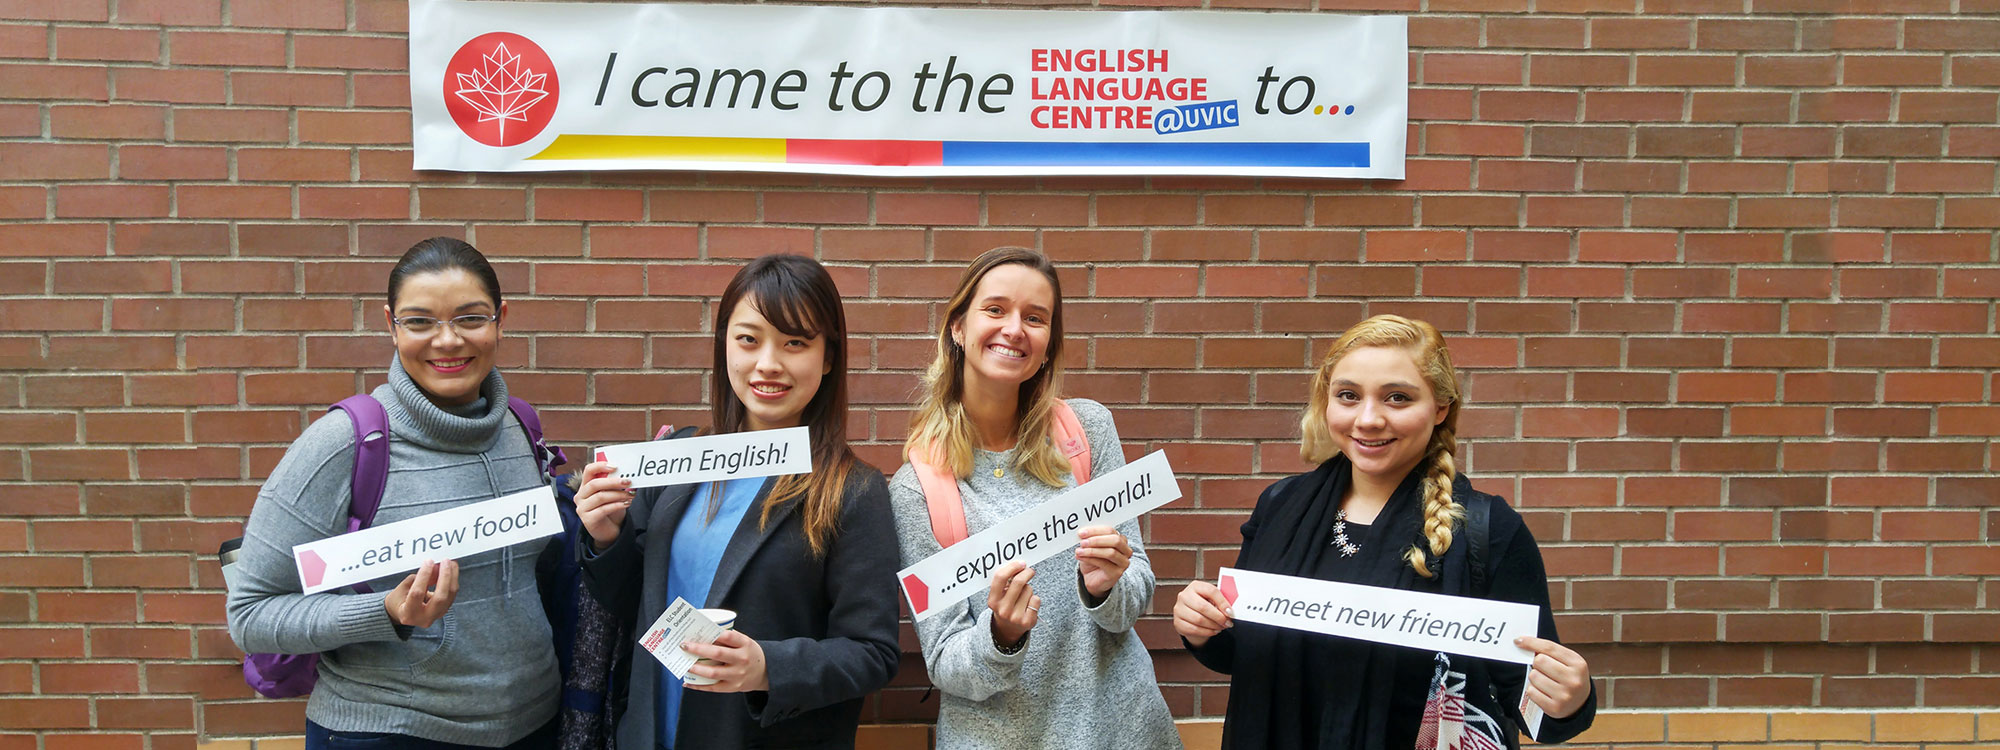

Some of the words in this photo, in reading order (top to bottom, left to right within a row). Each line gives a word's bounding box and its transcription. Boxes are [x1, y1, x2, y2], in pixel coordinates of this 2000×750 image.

[594, 52, 618, 106] I
[631, 66, 808, 111] came
[828, 61, 891, 112] to
[912, 55, 1014, 114] the
[1031, 48, 1169, 73] ENGLISH
[1031, 77, 1208, 101] LANGUAGE
[1254, 65, 1355, 116] to...
[1030, 105, 1153, 129] CENTRE
[1157, 104, 1237, 133] @UVIC
[620, 454, 692, 479] ...learn
[699, 442, 789, 475] English!
[341, 539, 404, 572] ...eat
[412, 527, 466, 555] new
[473, 504, 537, 540] food!
[941, 532, 1038, 594] ...explore
[1042, 512, 1079, 542] the
[1084, 472, 1152, 522] world!
[1247, 597, 1333, 621] ...meet
[1335, 607, 1396, 630] new
[1398, 608, 1507, 645] friends!
